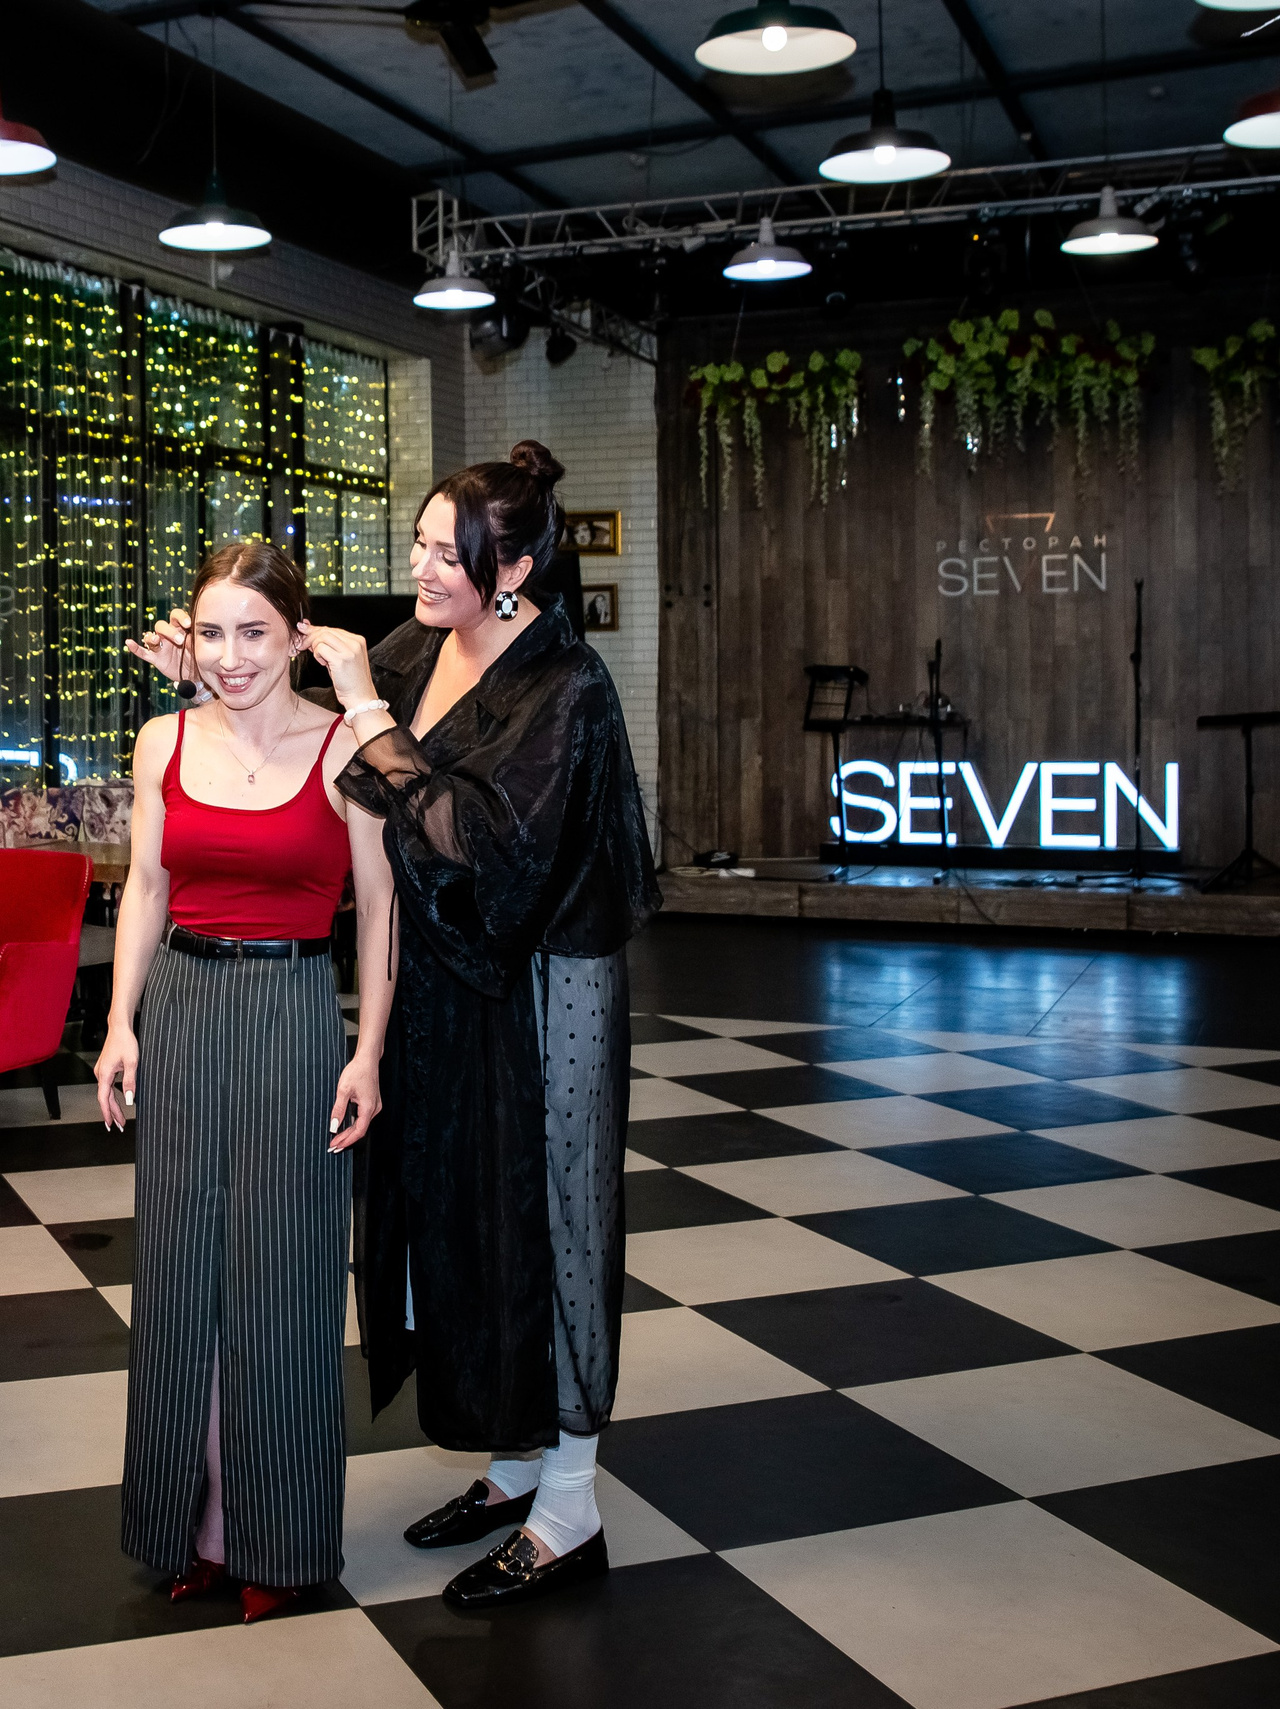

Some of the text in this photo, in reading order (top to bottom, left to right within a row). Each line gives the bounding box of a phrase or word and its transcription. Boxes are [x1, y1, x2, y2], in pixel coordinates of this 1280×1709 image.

[936, 534, 1106, 553] РЕСТОРАН
[938, 552, 1106, 596] SEVEN
[829, 759, 1179, 850] SEVEN
